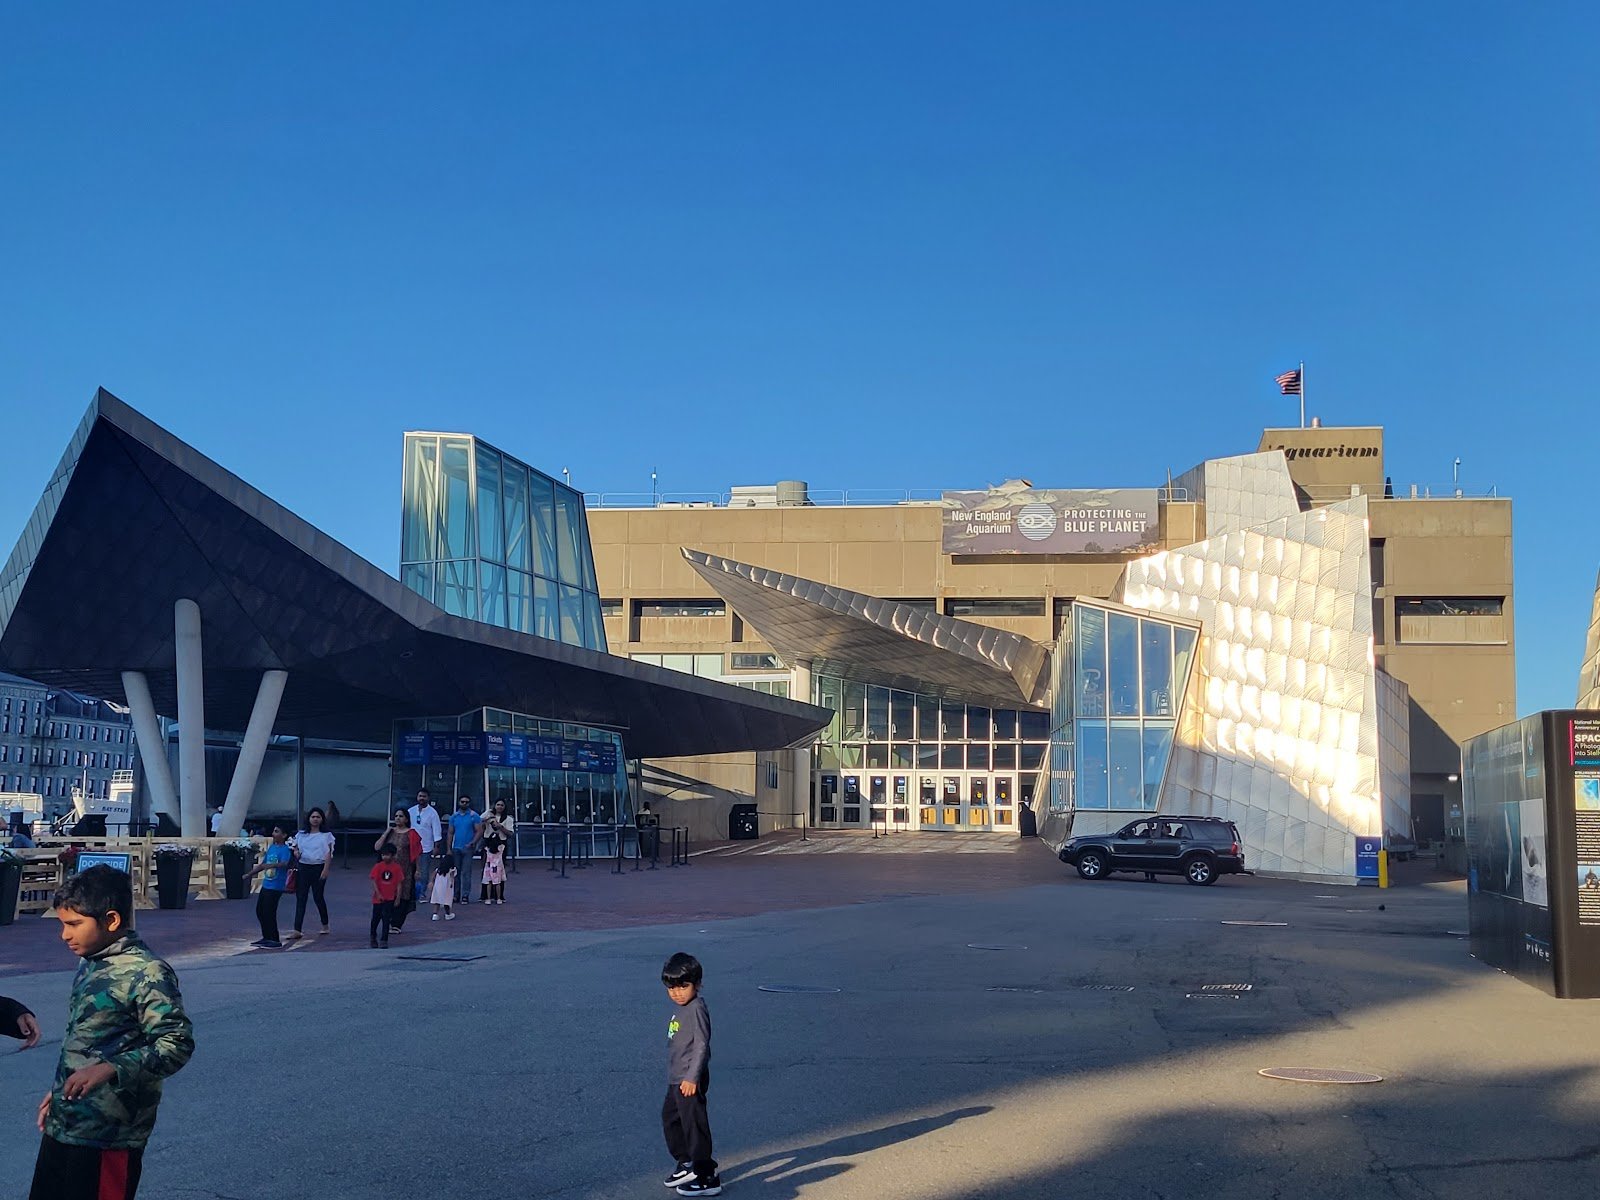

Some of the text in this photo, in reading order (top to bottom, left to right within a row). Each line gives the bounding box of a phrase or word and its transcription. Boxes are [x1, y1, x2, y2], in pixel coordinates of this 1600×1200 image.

[1268, 444, 1379, 461] quarium
[951, 510, 1011, 523] New England
[1064, 509, 1132, 519] PROTECTING
[966, 523, 1011, 536] Aquarium
[1064, 521, 1147, 533] BLUE PLANET
[488, 735, 503, 744] Tickets
[81, 859, 124, 869] DOCSIDE
